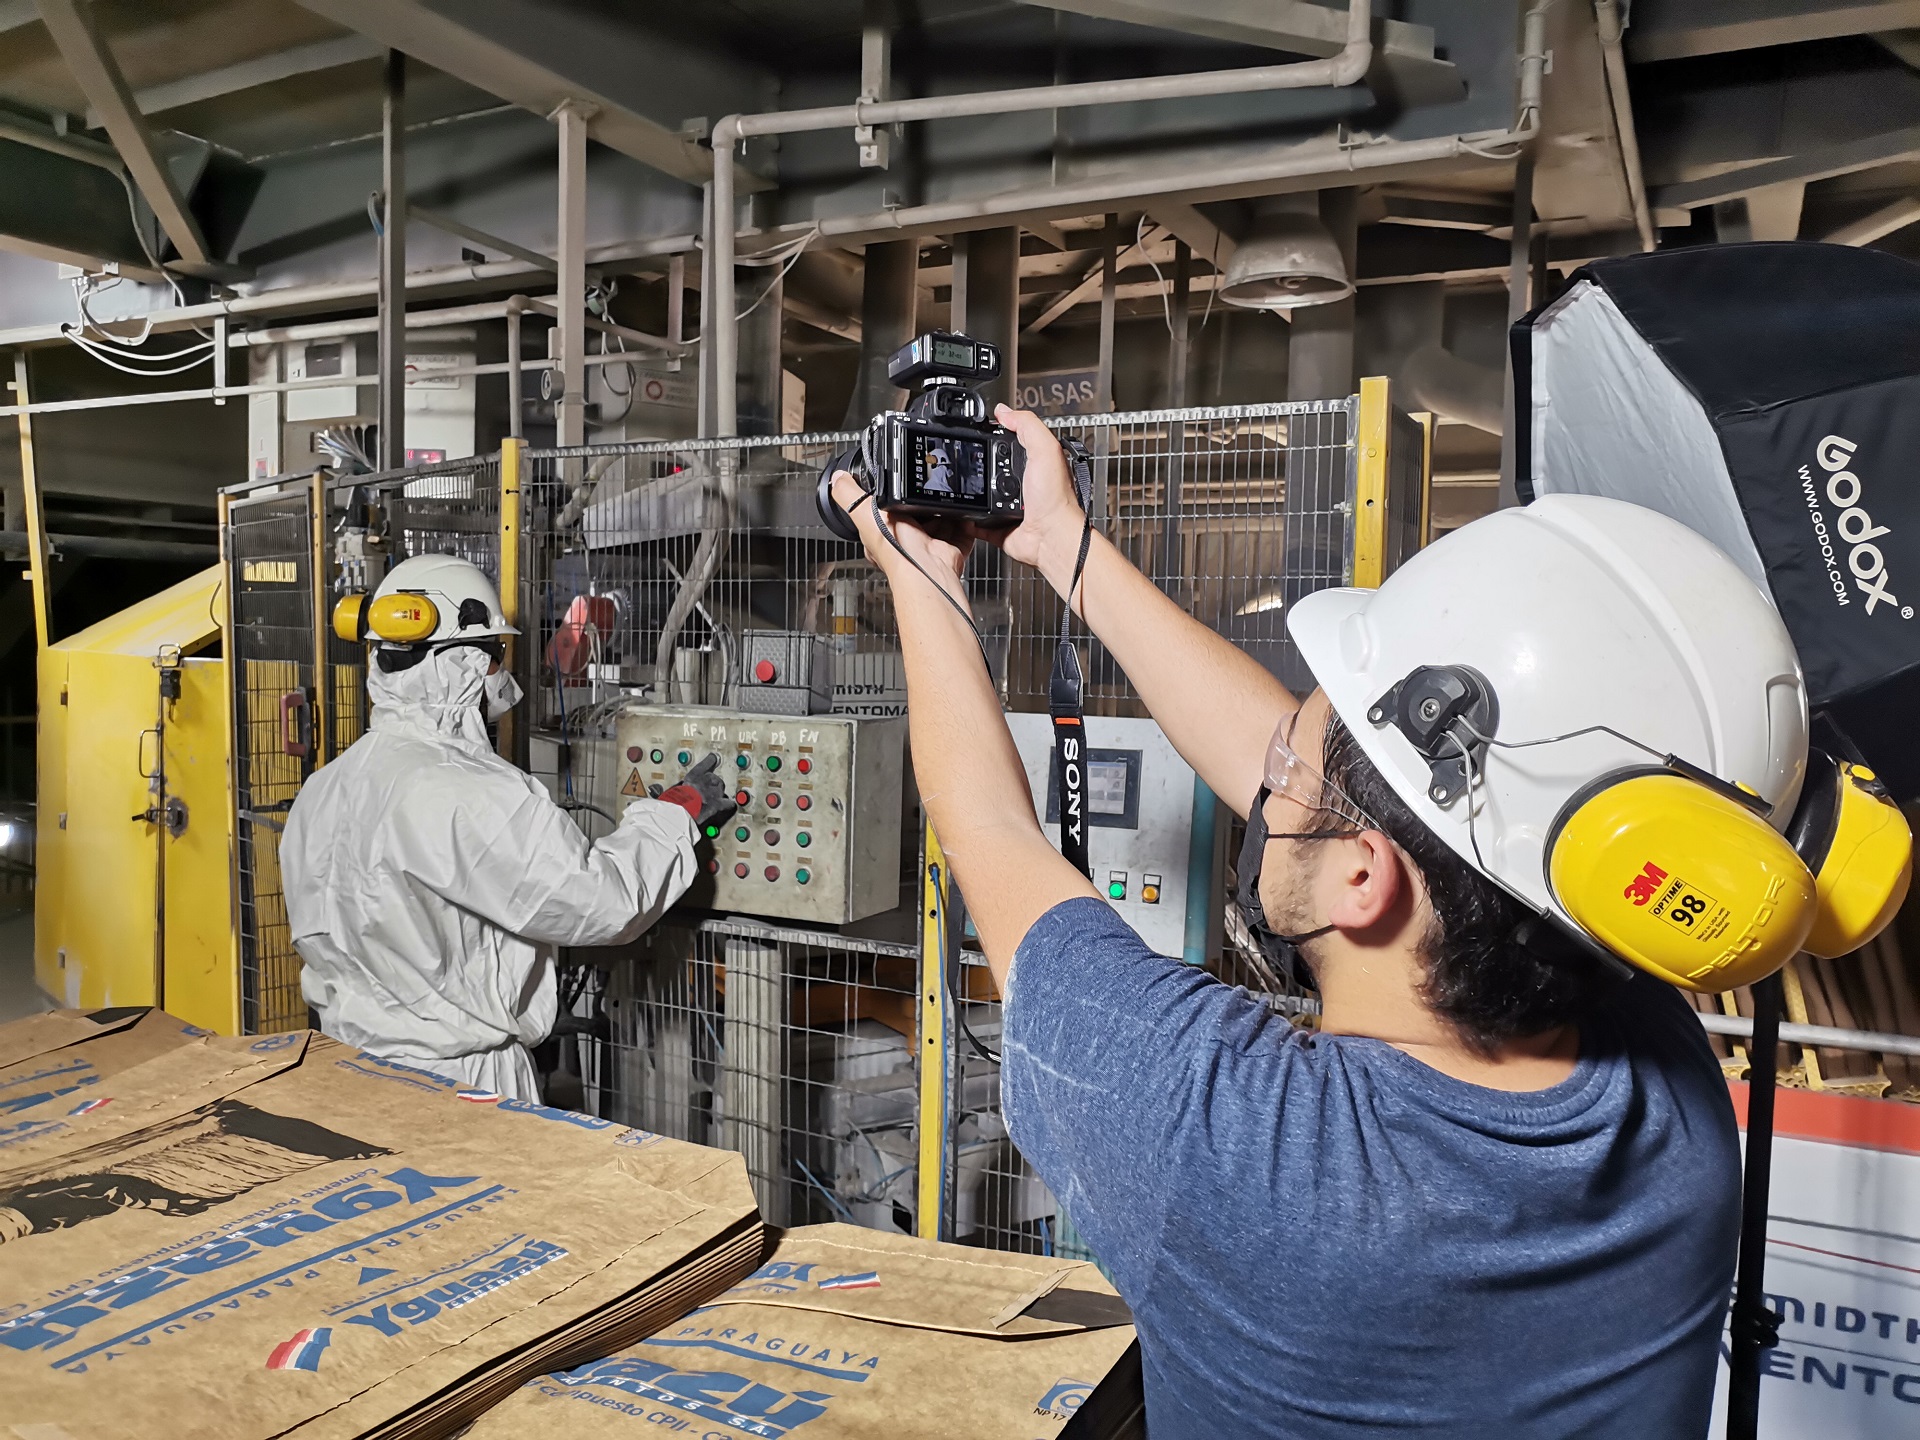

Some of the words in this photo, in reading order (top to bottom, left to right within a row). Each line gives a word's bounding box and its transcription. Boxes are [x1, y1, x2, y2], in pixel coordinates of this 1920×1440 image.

[1816, 434, 1899, 617] Godox
[1063, 737, 1081, 846] SONY
[1623, 860, 1669, 906] 3M
[1653, 879, 1684, 916] OPTIME
[1670, 894, 1706, 927] 98
[1686, 873, 1786, 979] PELTOR
[66, 1269, 322, 1374] PARAGUAYA
[341, 1238, 562, 1337] Yguazú
[678, 1327, 880, 1369] PARAGUAYA
